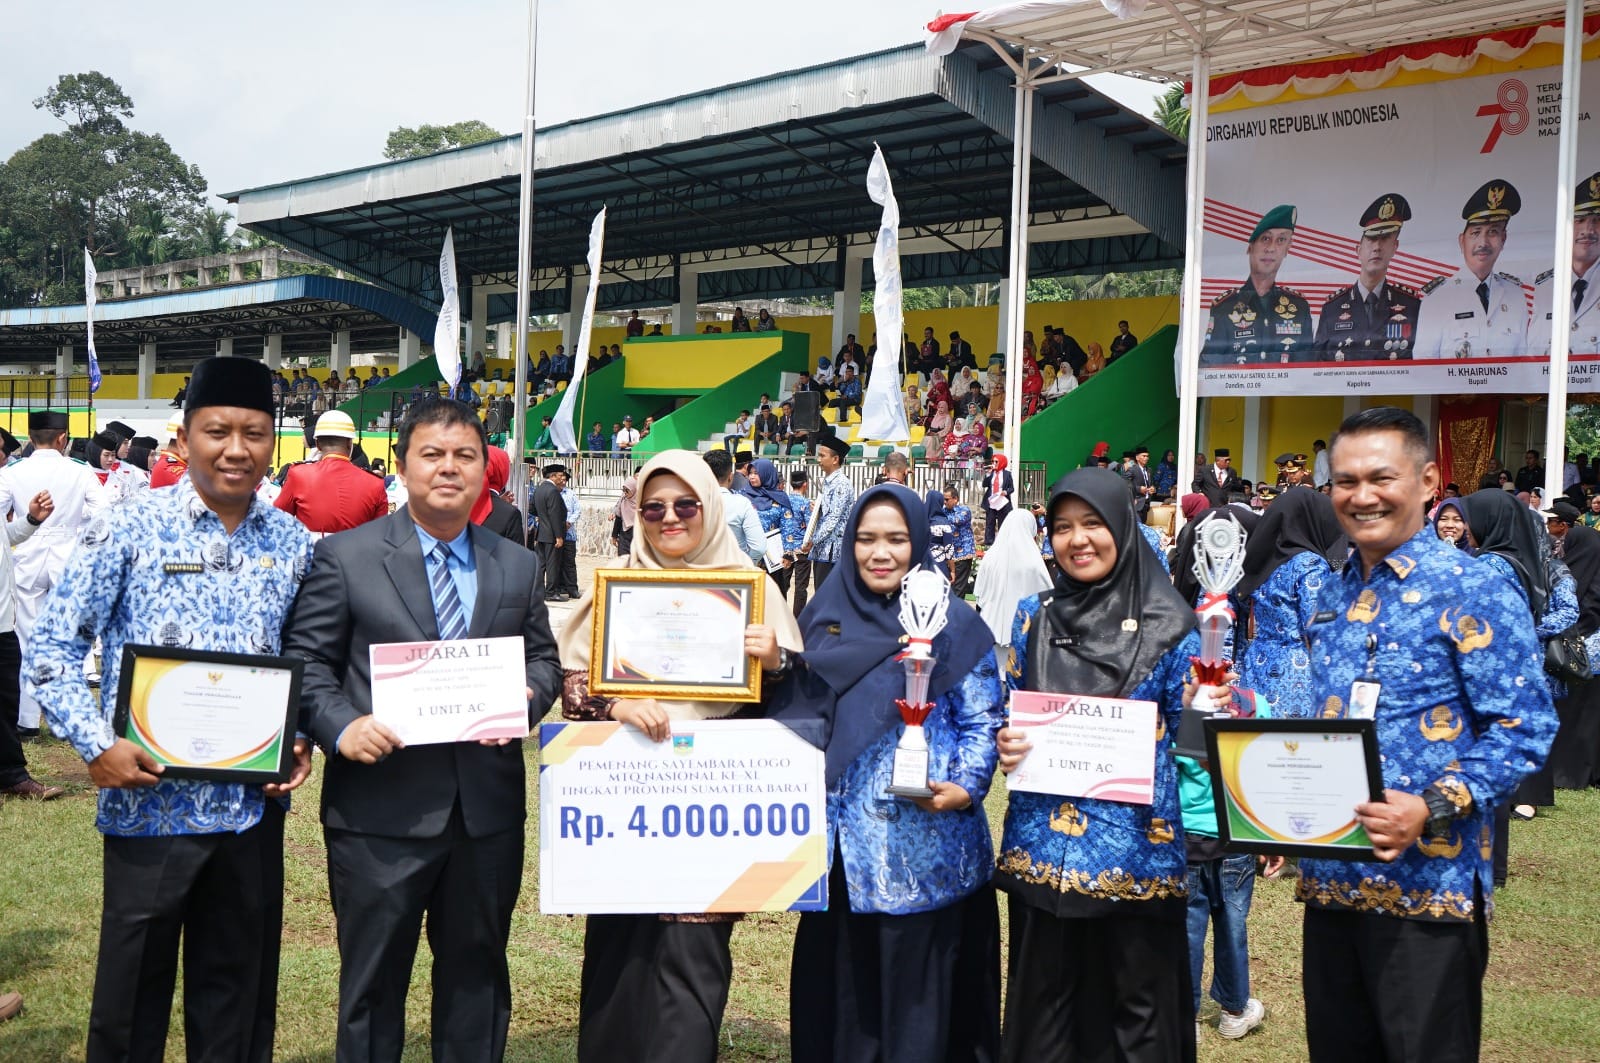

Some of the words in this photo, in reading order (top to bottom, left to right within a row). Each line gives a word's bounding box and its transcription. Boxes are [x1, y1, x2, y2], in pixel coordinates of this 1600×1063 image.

[1536, 82, 1562, 93] TERU
[1537, 94, 1562, 104] MELA
[1206, 120, 1266, 142] DIRGAHAYU
[1269, 112, 1330, 135] REPUBLIK
[1332, 103, 1399, 128] INDONESIA
[1476, 79, 1530, 154] 78
[1538, 112, 1591, 126] INDOIA
[1538, 128, 1560, 137] MAJ
[1448, 368, 1457, 376] H.
[1458, 366, 1508, 376] KHAIRUNAS
[1347, 380, 1371, 389] Kapolres
[1468, 377, 1488, 386] Bupati
[1571, 376, 1592, 385] Bupati
[405, 645, 470, 662] JUARA
[477, 644, 490, 657] II
[430, 704, 462, 715] UNIT
[468, 703, 486, 713] AC
[1042, 700, 1103, 718] JUARA
[1111, 705, 1124, 719] II
[579, 760, 658, 771] PEMENANG
[662, 759, 745, 770] SAYEMBARA
[749, 758, 791, 769] LOGO
[1048, 758, 1053, 768] 1
[1060, 760, 1091, 771] UNIT
[1096, 763, 1113, 773] AC
[608, 772, 645, 784] MTQ
[644, 771, 715, 781] NASIONAL
[561, 786, 620, 796] TINGKAT
[624, 785, 688, 796] PROVINSI
[691, 784, 763, 794] SUMATERA
[767, 782, 809, 793] BARAT
[560, 805, 614, 846] Rp.
[627, 803, 811, 838] 4.000.000
